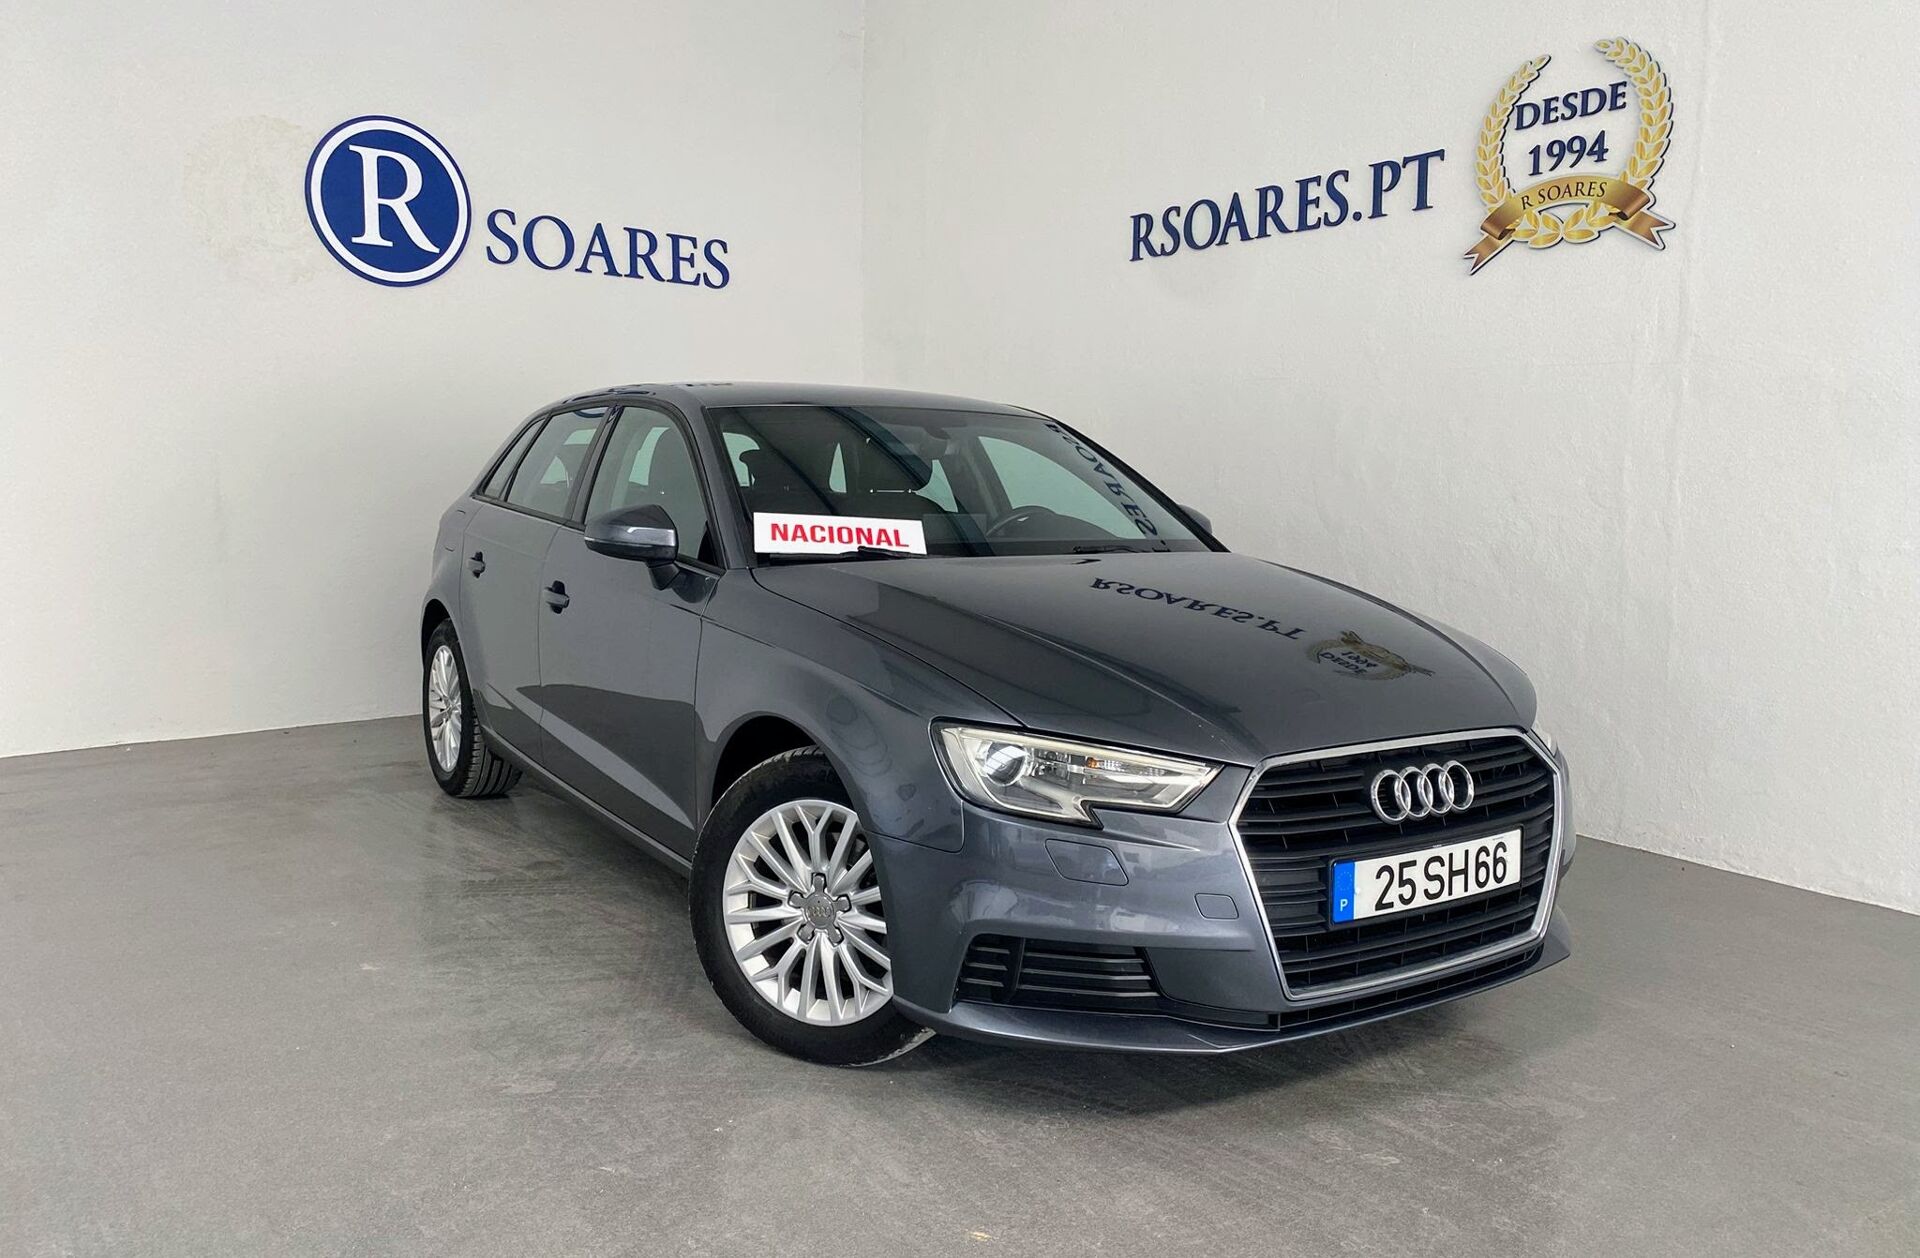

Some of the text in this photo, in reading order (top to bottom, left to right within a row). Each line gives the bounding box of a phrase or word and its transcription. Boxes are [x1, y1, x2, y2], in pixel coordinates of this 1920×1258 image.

[1514, 81, 1627, 132] DESDE
[1527, 130, 1609, 176] 1994
[349, 143, 731, 290] R SOARES
[1129, 148, 1445, 262] RSOARES.PT
[1521, 181, 1608, 210] R SOARES
[770, 523, 909, 548] NACIONAL
[1339, 898, 1348, 911] P
